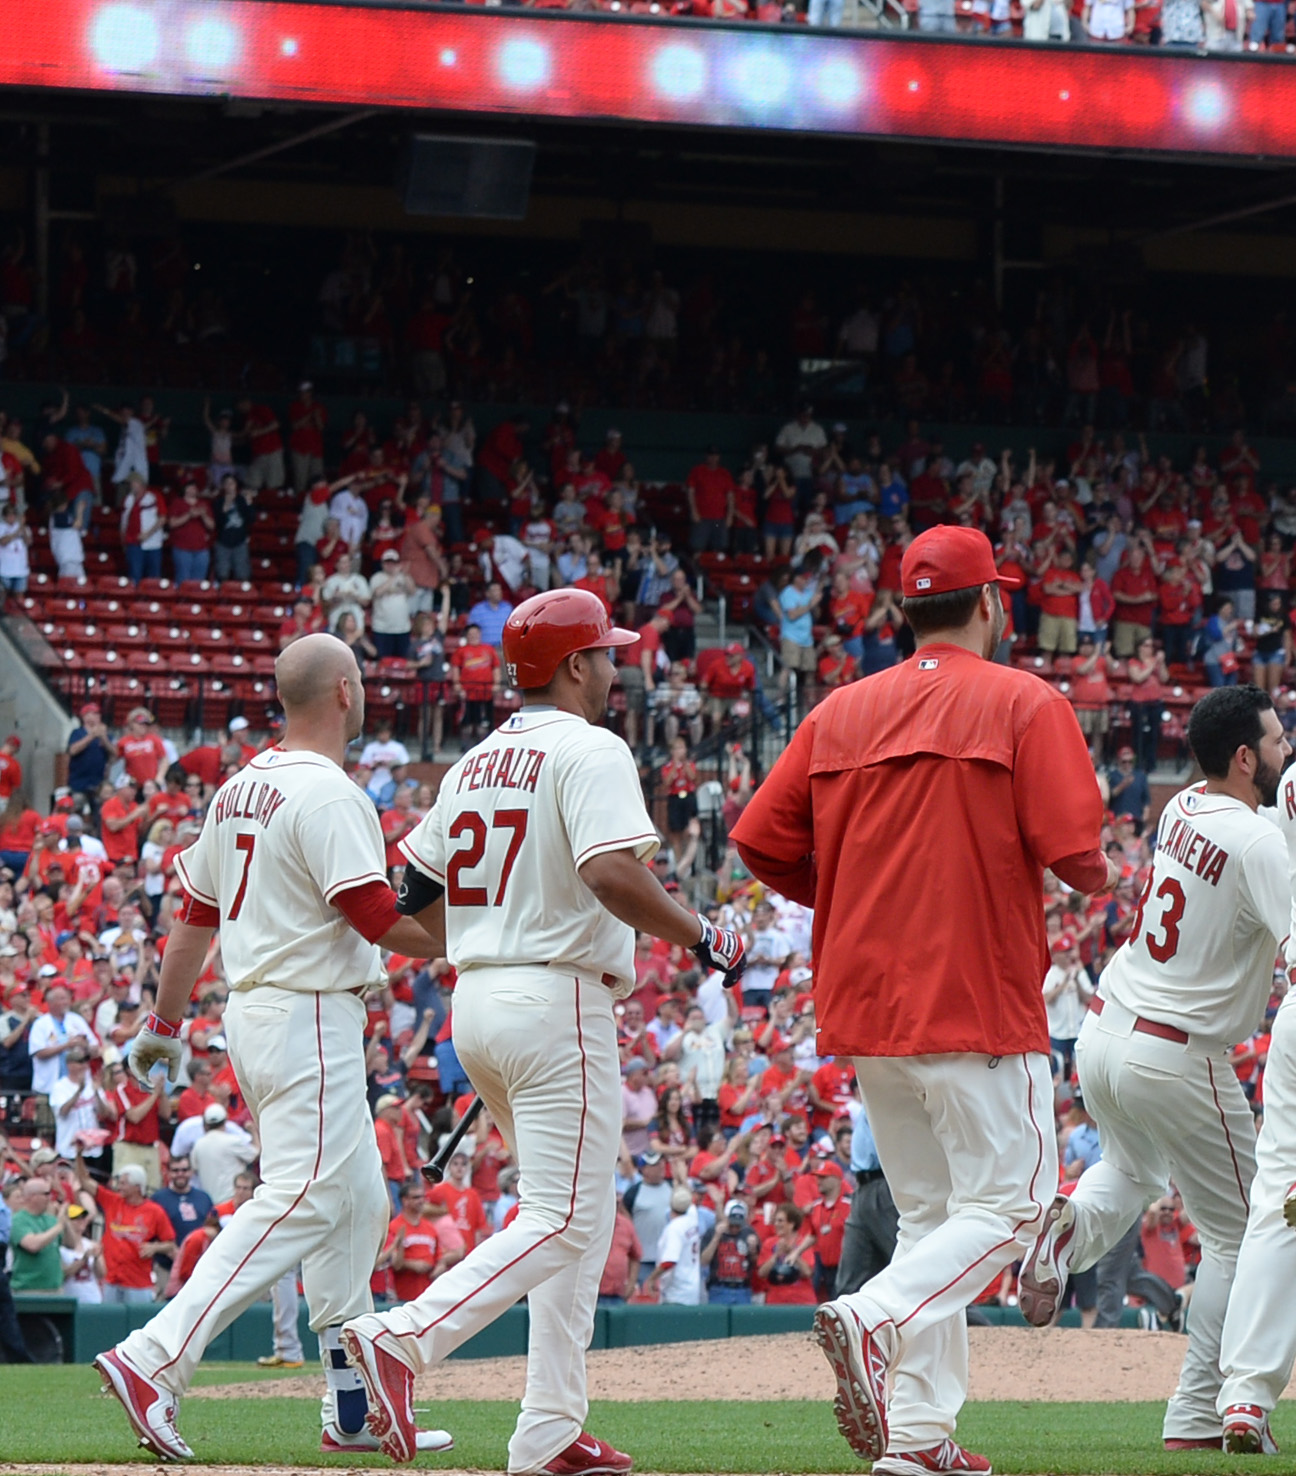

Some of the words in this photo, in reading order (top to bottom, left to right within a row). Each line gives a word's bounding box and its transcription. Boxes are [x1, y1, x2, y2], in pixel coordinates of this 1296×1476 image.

[456, 747, 547, 794] PERALTA
[227, 833, 255, 920] 7
[446, 808, 528, 907] 27
